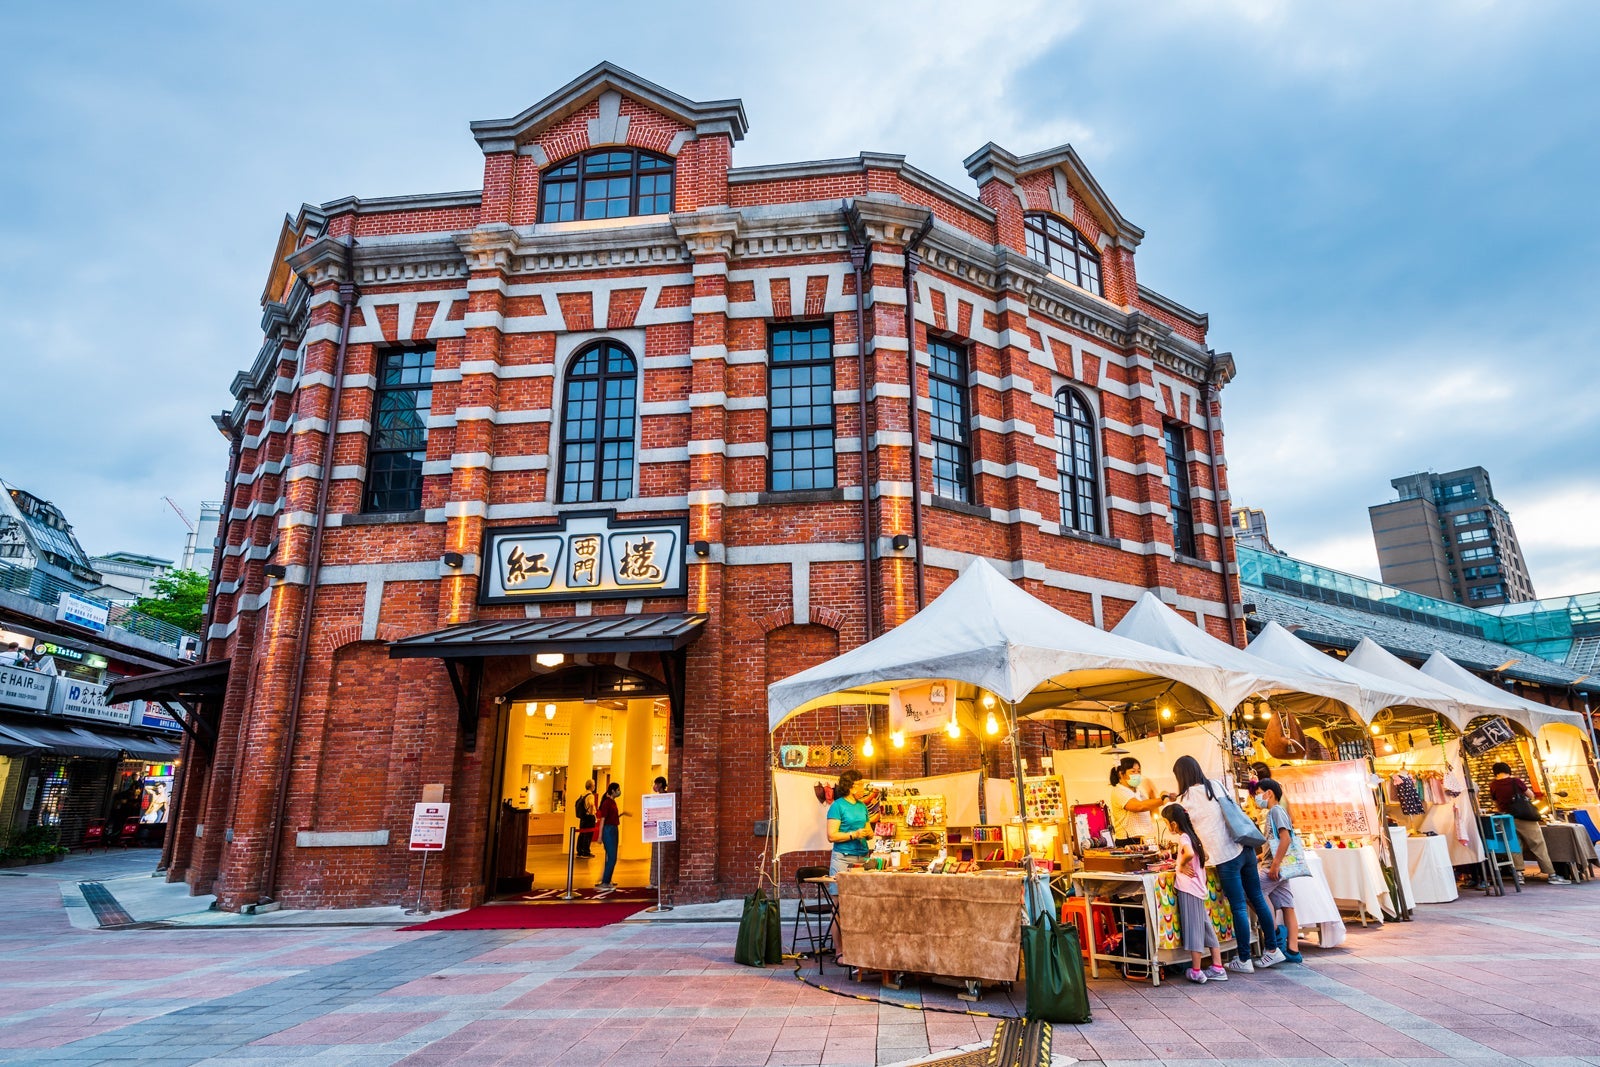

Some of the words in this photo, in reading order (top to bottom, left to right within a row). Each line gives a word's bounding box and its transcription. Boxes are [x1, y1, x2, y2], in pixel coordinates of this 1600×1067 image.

[506, 545, 551, 584] 紅
[573, 537, 599, 583] 西門
[619, 536, 661, 580] 樓
[9, 672, 34, 689] HAIR
[69, 685, 81, 701] HD
[1478, 742, 1492, 753] EXIT
